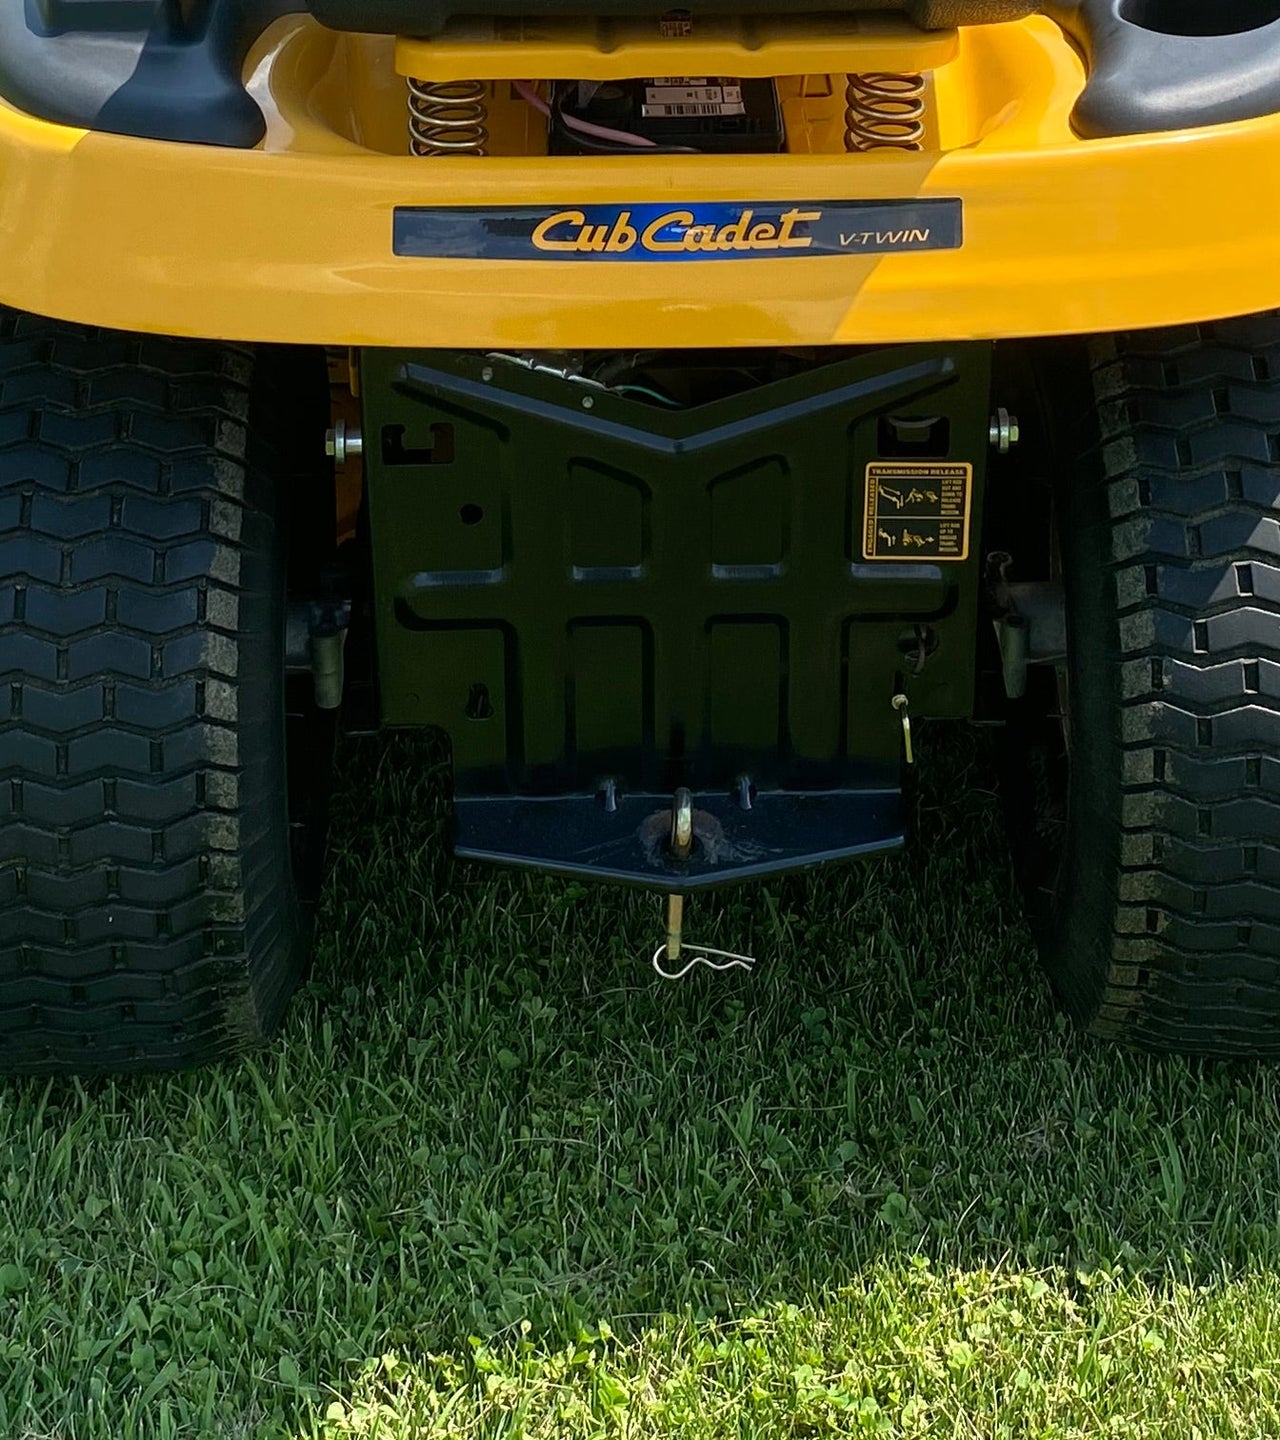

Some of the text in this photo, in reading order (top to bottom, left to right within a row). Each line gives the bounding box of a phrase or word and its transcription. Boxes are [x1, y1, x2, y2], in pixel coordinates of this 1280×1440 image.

[531, 208, 822, 252] Cub Cadet
[838, 228, 930, 247] V-TWIN
